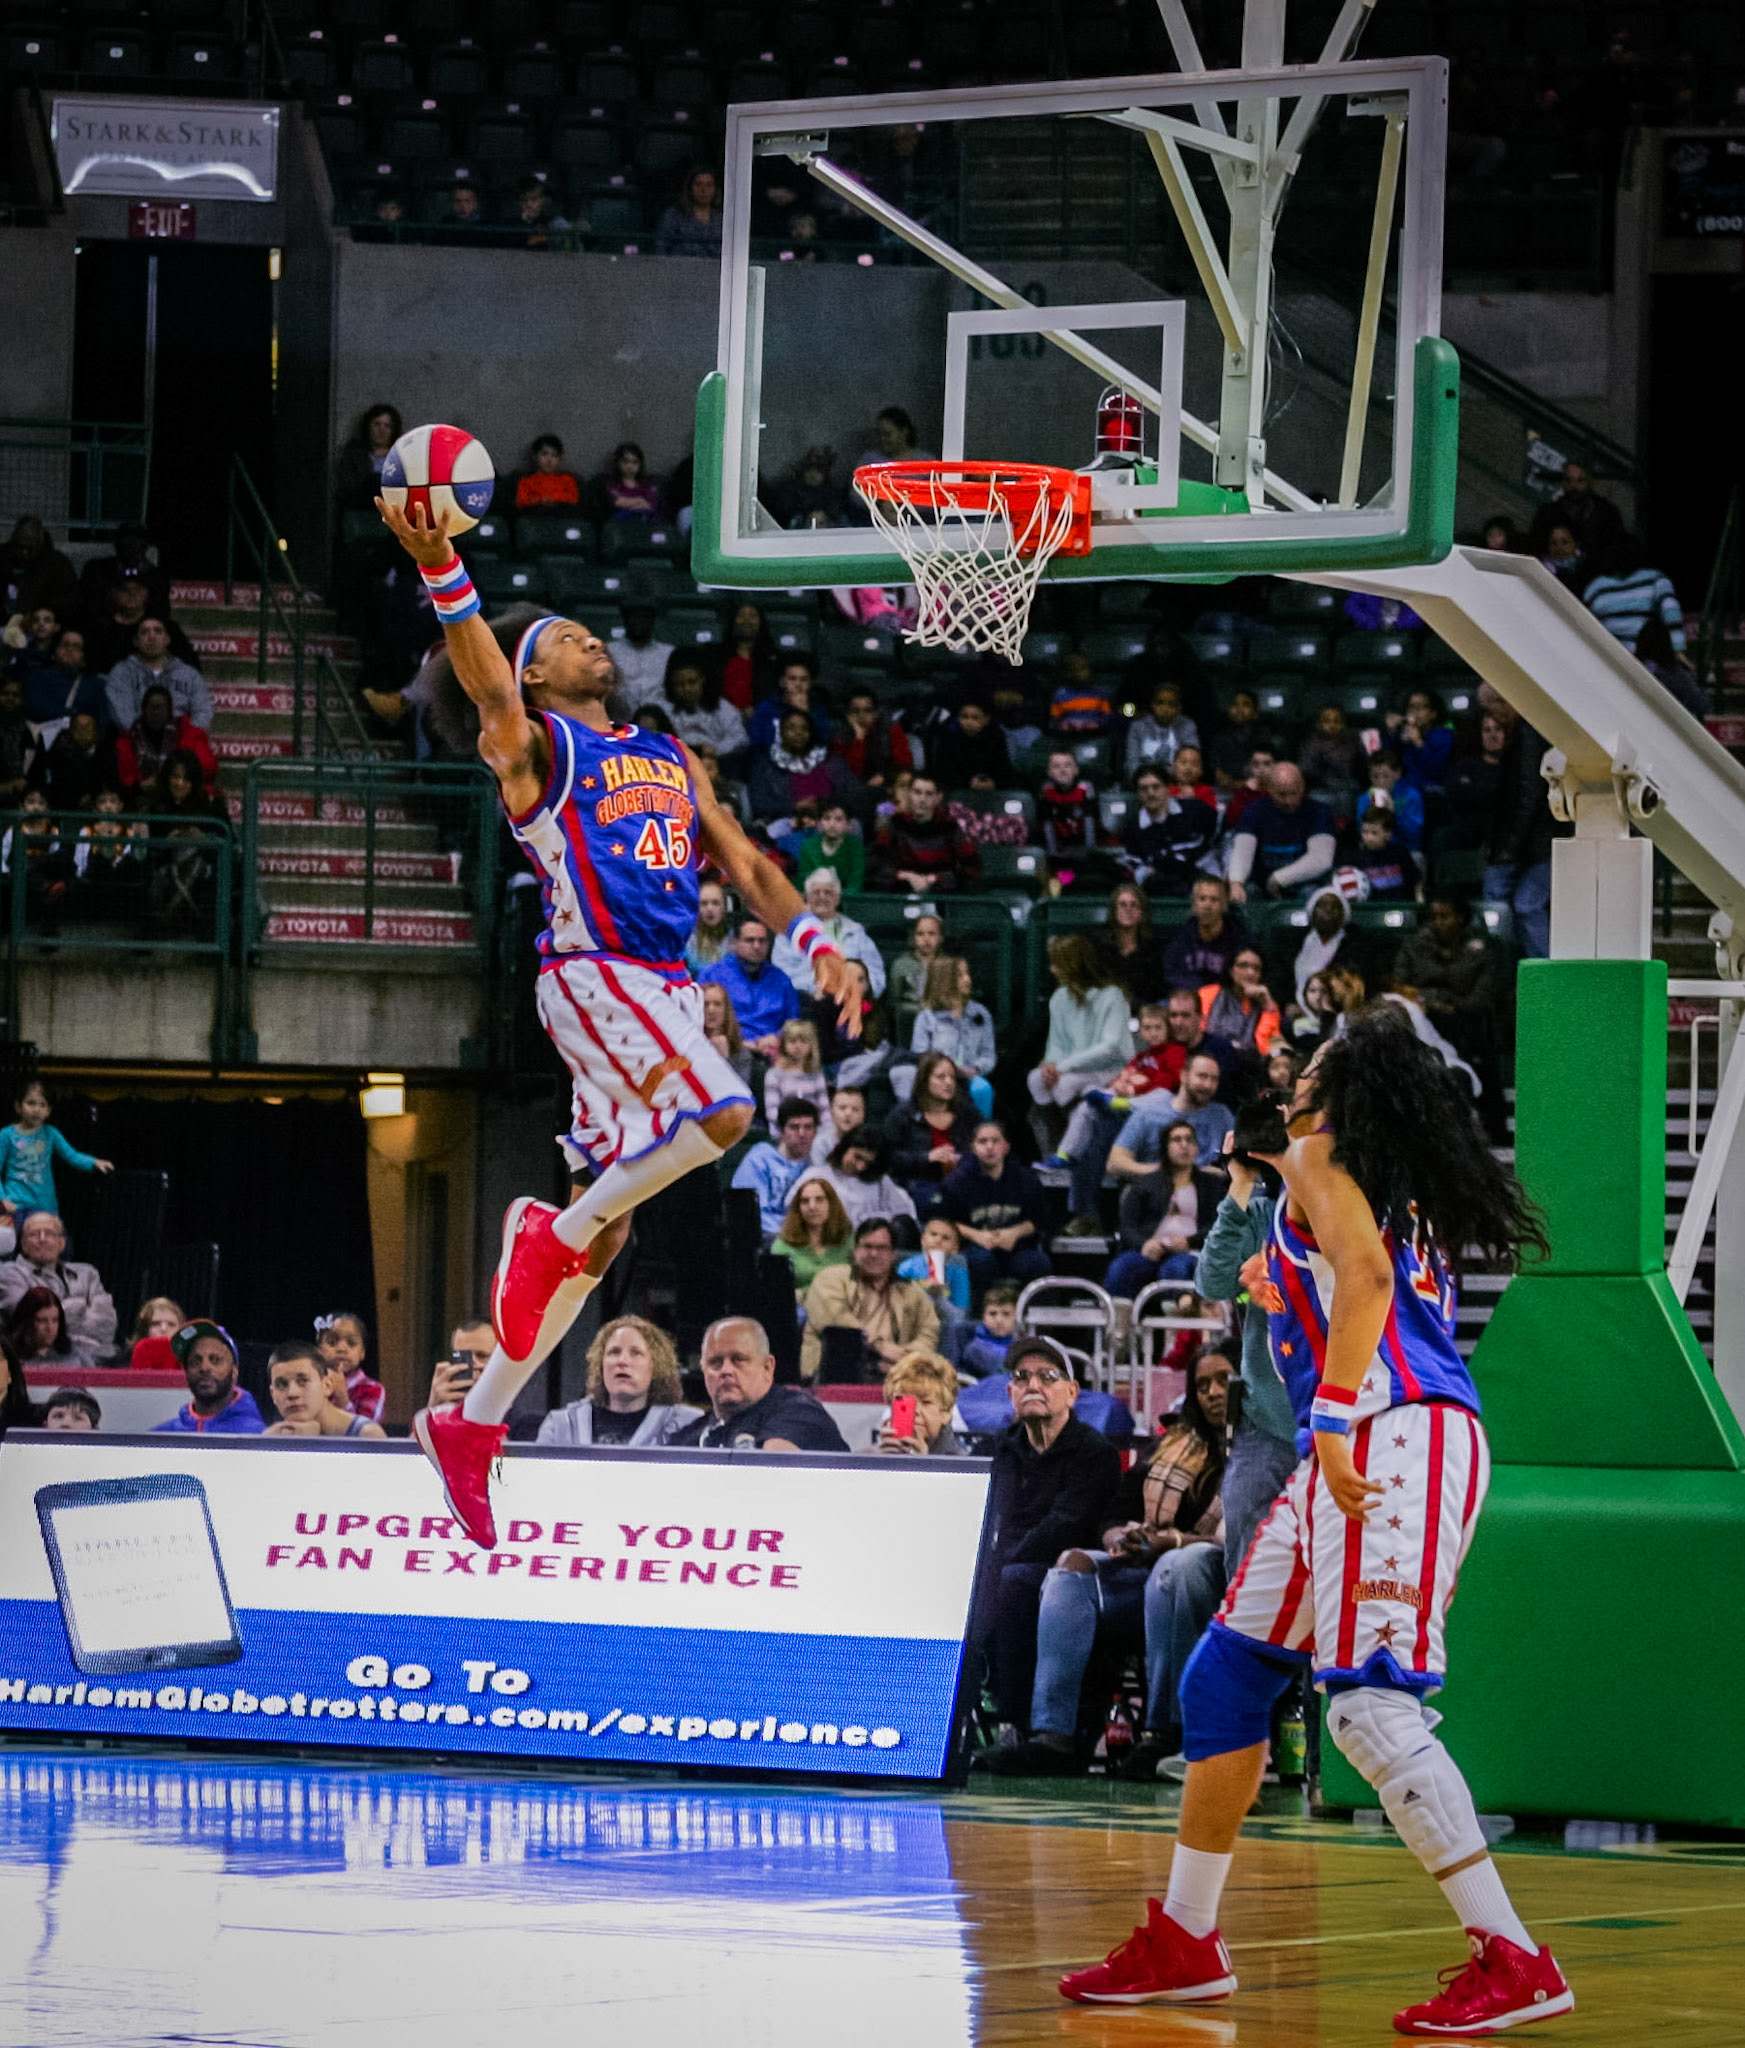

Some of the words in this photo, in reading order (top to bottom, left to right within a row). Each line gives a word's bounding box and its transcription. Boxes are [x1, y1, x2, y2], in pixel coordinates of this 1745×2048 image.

[142, 206, 184, 237] EXIT
[1696, 214, 1745, 234] (800
[221, 742, 281, 756] TOYOTA
[600, 754, 689, 796] HARLEM
[634, 818, 692, 870] 45
[268, 859, 331, 874] TOYOTA
[286, 918, 350, 934] TOYOTA
[390, 921, 455, 939] TOYOTA
[294, 1513, 584, 1547] UPGRDE
[618, 1523, 785, 1554] YOUR
[266, 1544, 373, 1571] FAN
[404, 1549, 803, 1590] EXPERIENCE
[1352, 1579, 1424, 1611] HARLEM
[346, 1655, 432, 1690] Go
[462, 1659, 531, 1696] To
